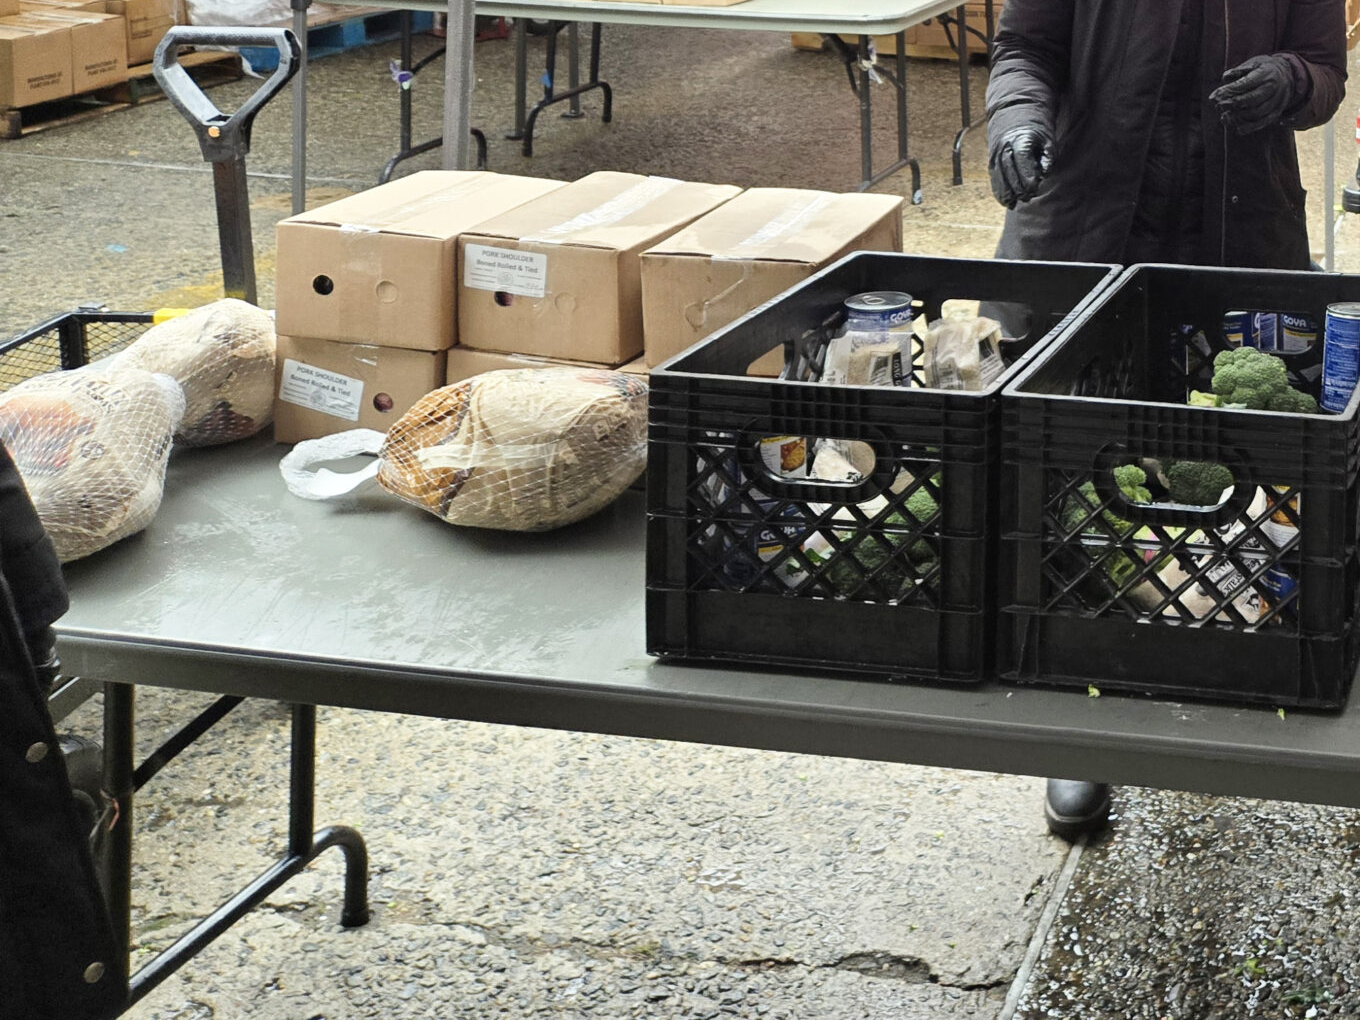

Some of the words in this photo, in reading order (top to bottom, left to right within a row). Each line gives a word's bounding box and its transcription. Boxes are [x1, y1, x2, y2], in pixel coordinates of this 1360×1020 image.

[482, 249, 499, 258] PORK
[500, 252, 534, 263] SHOULDER
[476, 259, 497, 268] Boned
[497, 261, 517, 270] Rolled
[525, 265, 539, 274] Tied
[1283, 314, 1307, 328] GOYA
[296, 365, 313, 376] PORK
[315, 371, 348, 386] SHOULDER
[290, 373, 310, 385] Boned
[311, 379, 330, 391] Rolled
[337, 387, 351, 397] Tied
